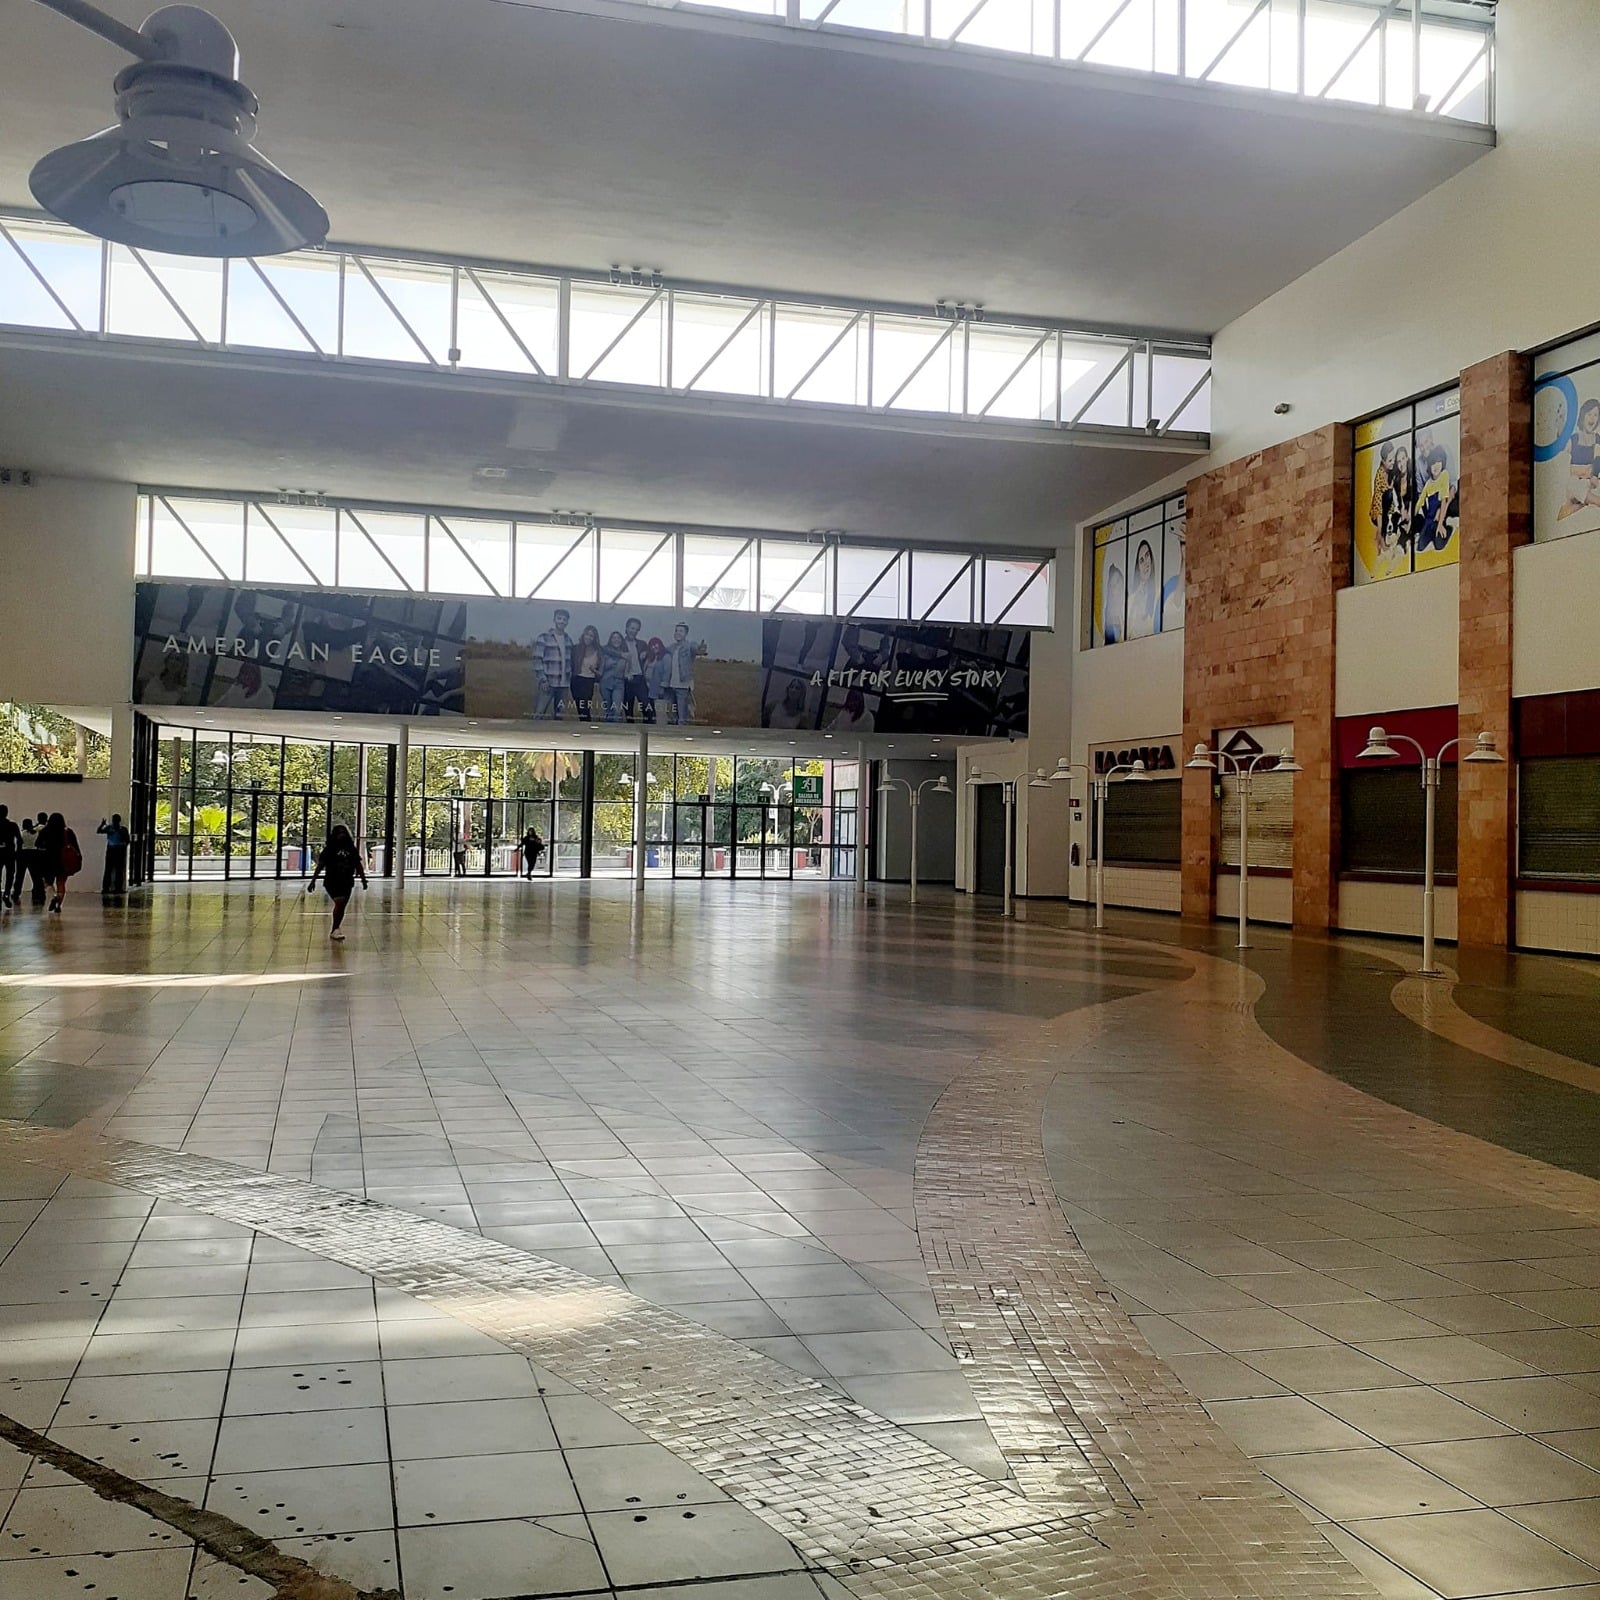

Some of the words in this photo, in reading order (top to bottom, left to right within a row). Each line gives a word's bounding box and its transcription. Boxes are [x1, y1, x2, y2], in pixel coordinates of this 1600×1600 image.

[162, 635, 330, 662] AMERICAN
[351, 644, 441, 668] EAGLE
[810, 671, 824, 687] A
[827, 669, 858, 687] FIT
[860, 669, 891, 688] FOR
[950, 669, 1007, 688] STORY
[557, 699, 629, 711] AMERICAN
